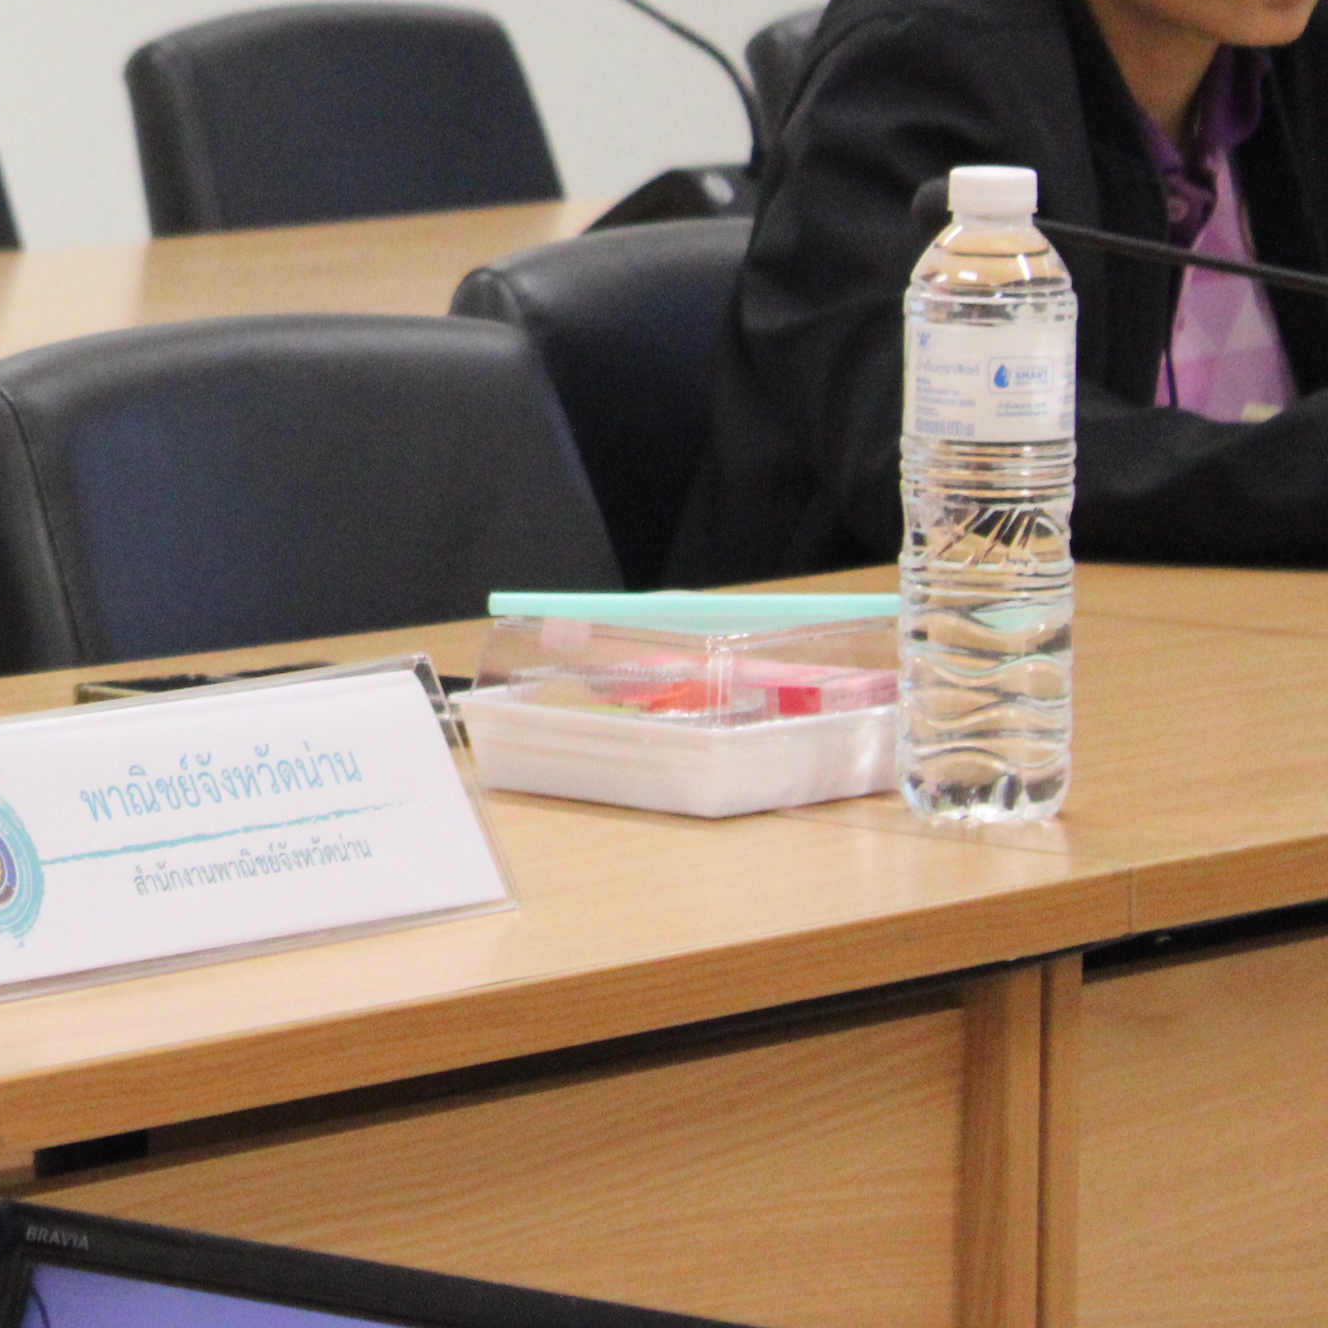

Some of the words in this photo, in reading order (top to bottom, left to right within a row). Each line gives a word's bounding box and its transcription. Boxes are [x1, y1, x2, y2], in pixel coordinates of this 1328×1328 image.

[80, 741, 362, 822] พาณิชย์จังหวัดน่าน
[133, 834, 372, 896] สำนักงานพาณิชย์จังหวัดน่าน
[26, 1225, 89, 1251] BRAVIA
